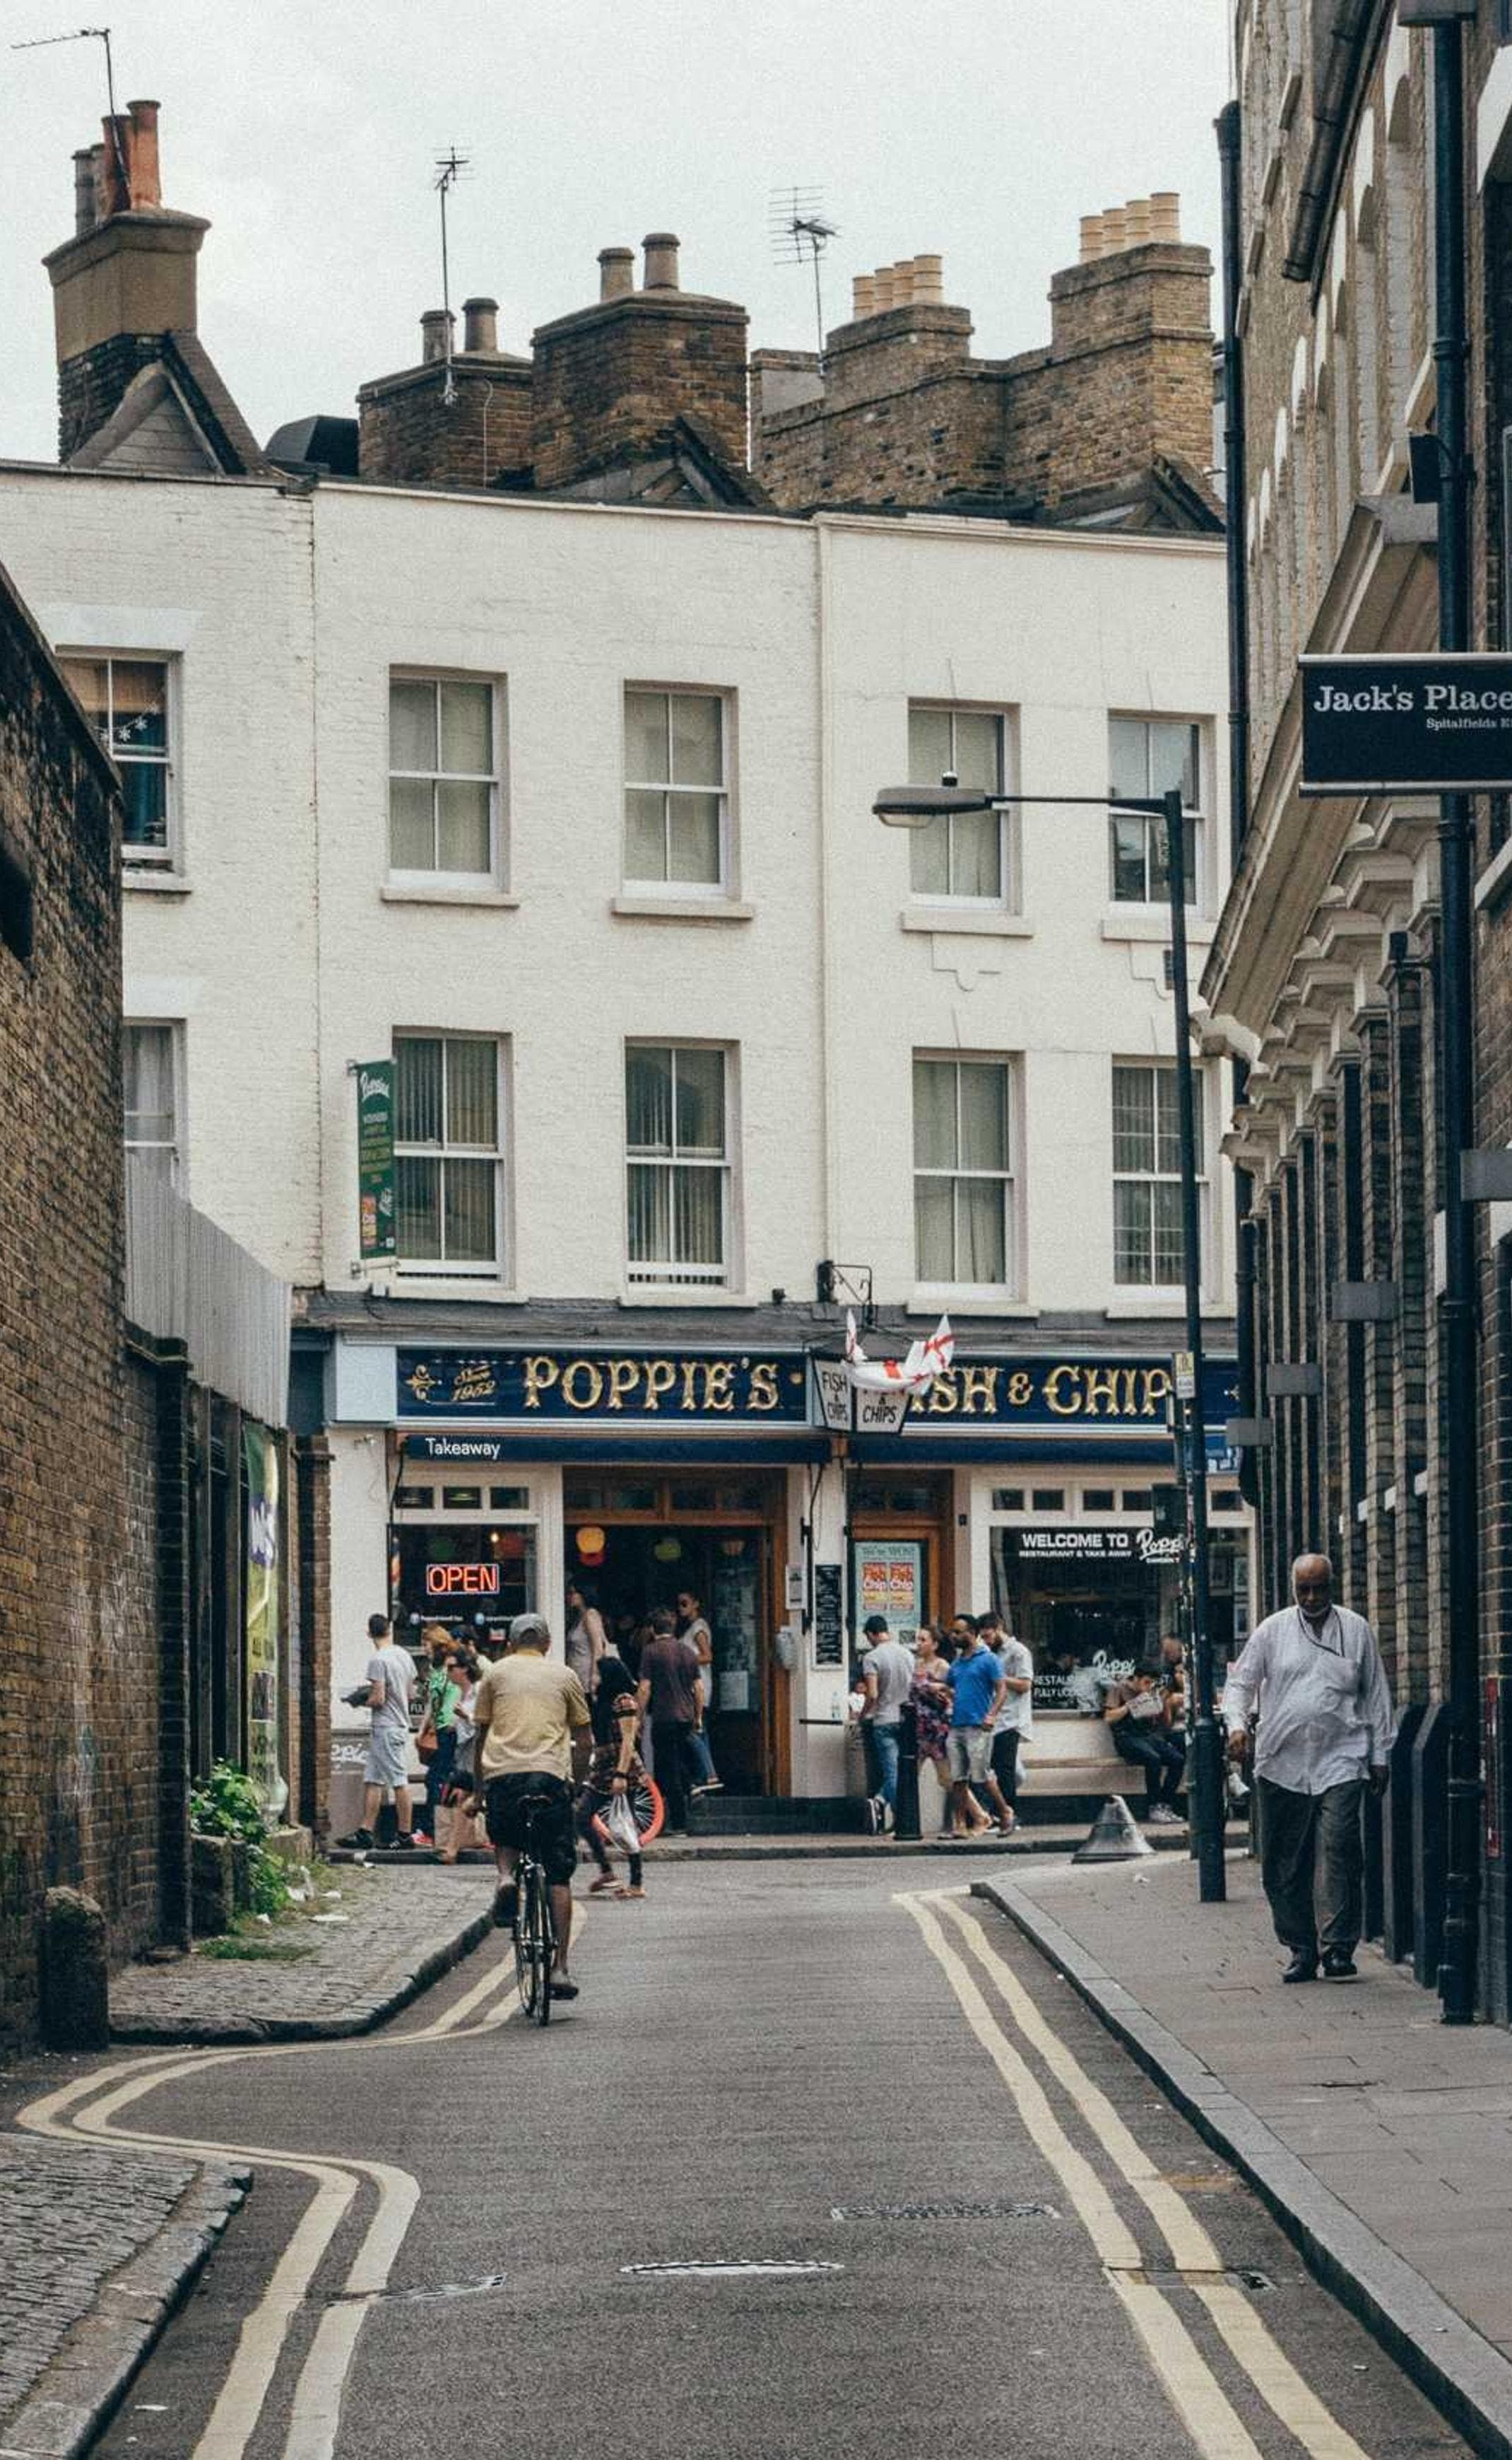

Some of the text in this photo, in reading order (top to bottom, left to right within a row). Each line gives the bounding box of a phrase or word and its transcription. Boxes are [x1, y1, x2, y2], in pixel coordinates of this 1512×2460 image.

[1313, 683, 1512, 712] Jack's Place
[1427, 716, 1497, 731] Spitalfields
[524, 1356, 778, 1410] POPPIE'S
[822, 1371, 848, 1392] FISH
[909, 1364, 1173, 1416] SH & CHIP
[862, 1405, 897, 1424] CHIPS
[425, 1437, 502, 1460] Takeaway
[1022, 1533, 1129, 1548] WELCOME TO
[429, 1566, 497, 1592] OPEN
